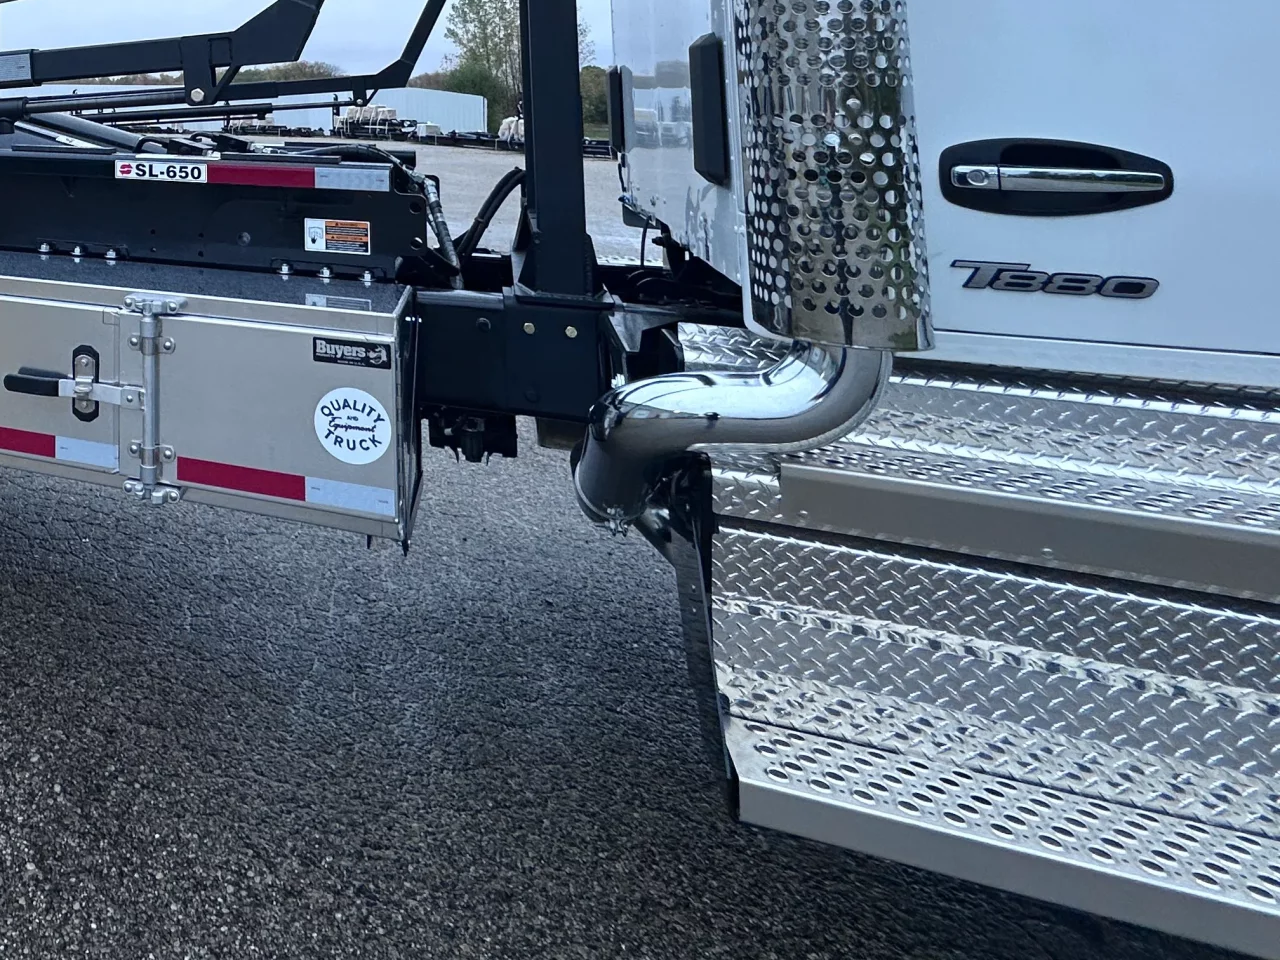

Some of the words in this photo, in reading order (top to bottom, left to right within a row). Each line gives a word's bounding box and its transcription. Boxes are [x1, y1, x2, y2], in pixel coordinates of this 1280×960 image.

[135, 163, 202, 179] SL-650
[950, 259, 1160, 299] T880
[315, 339, 366, 358] Buyers
[320, 398, 385, 423] QUALITY
[324, 428, 382, 451] TRUCK
